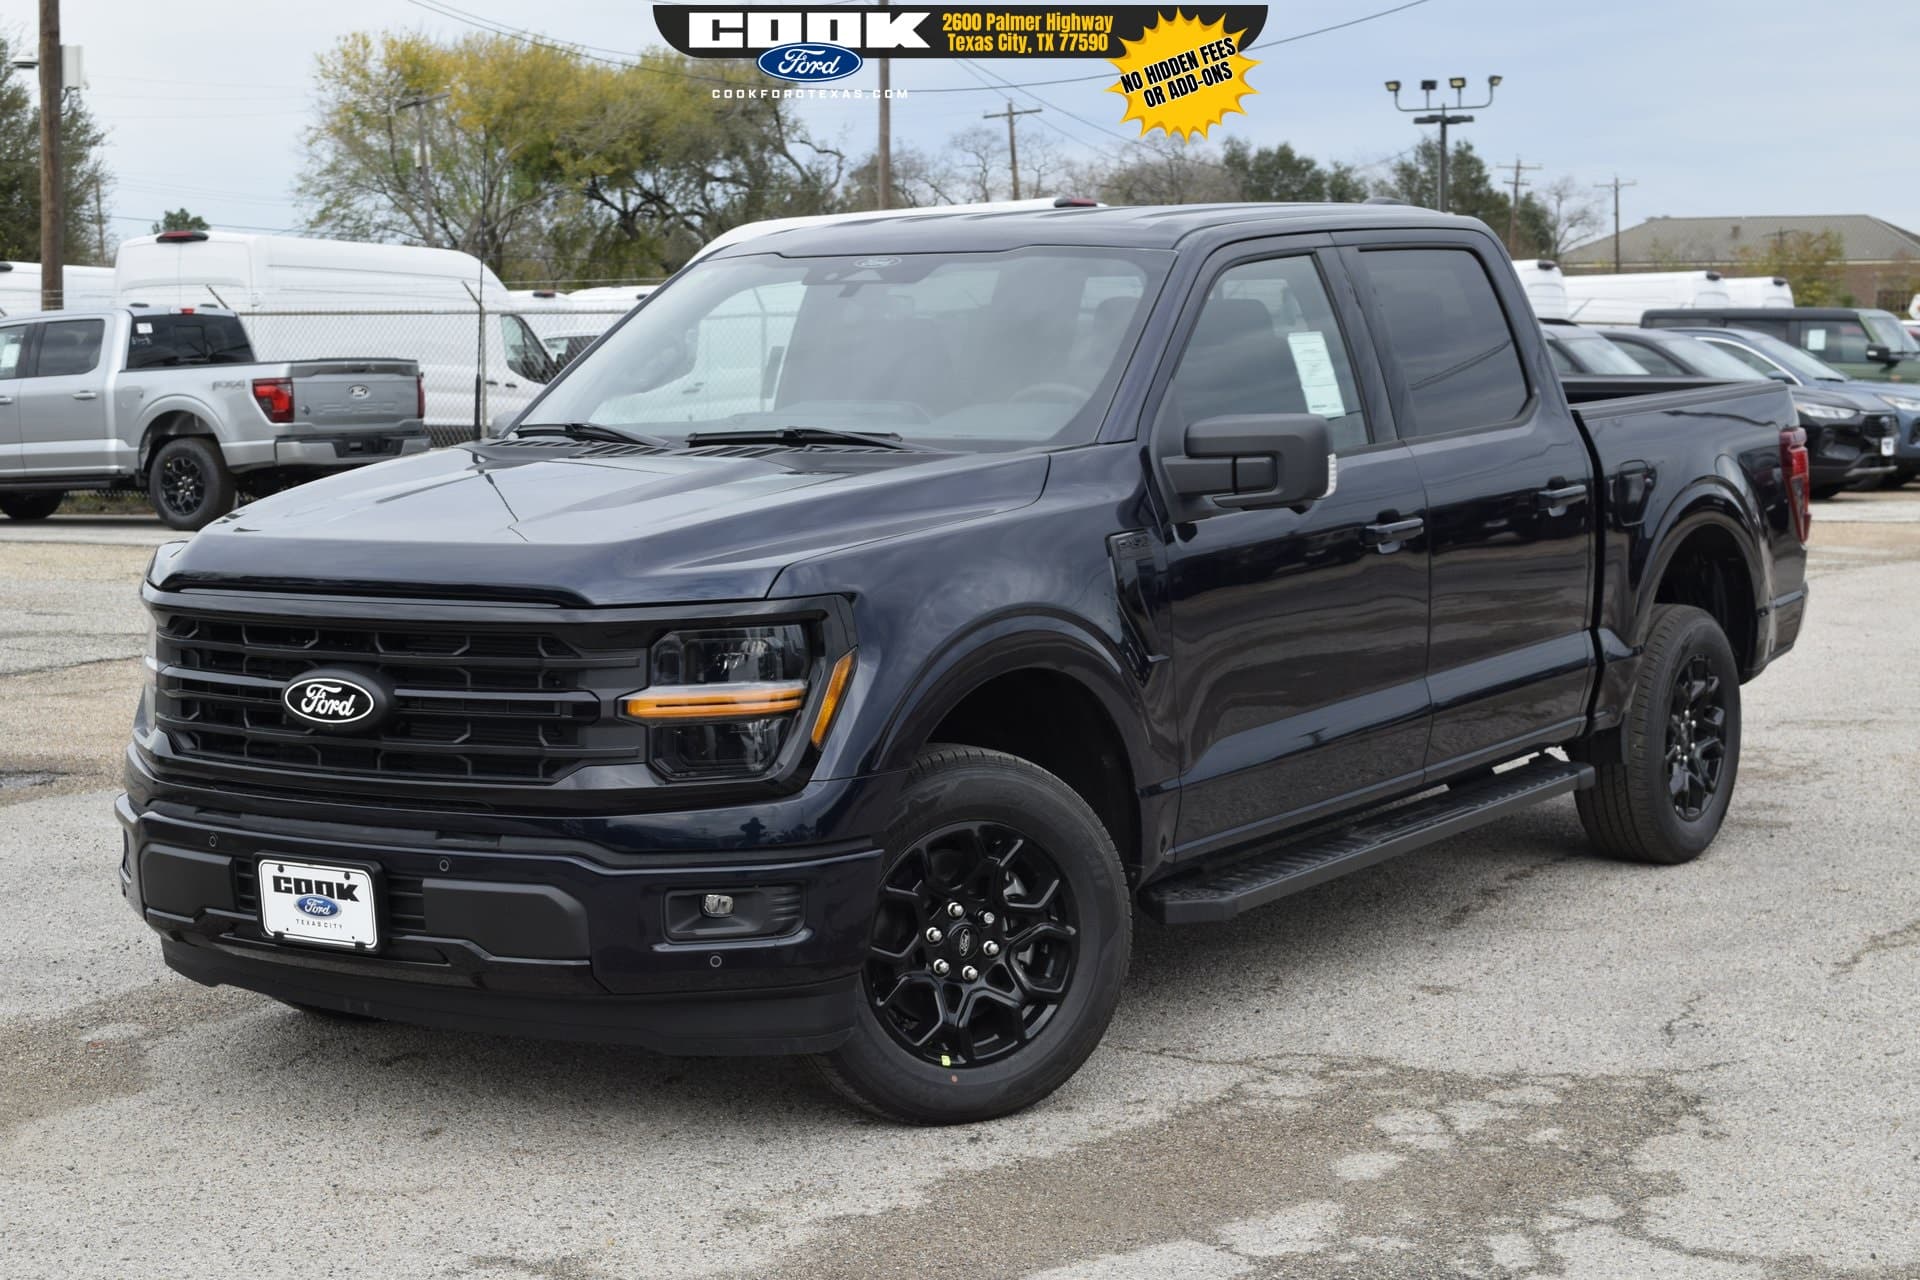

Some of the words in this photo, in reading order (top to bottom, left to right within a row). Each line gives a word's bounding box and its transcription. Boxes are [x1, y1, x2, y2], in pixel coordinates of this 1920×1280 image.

[301, 684, 356, 716] Ford
[272, 875, 360, 902] COOK
[304, 898, 331, 915] Ford
[296, 918, 322, 928] TEXAS
